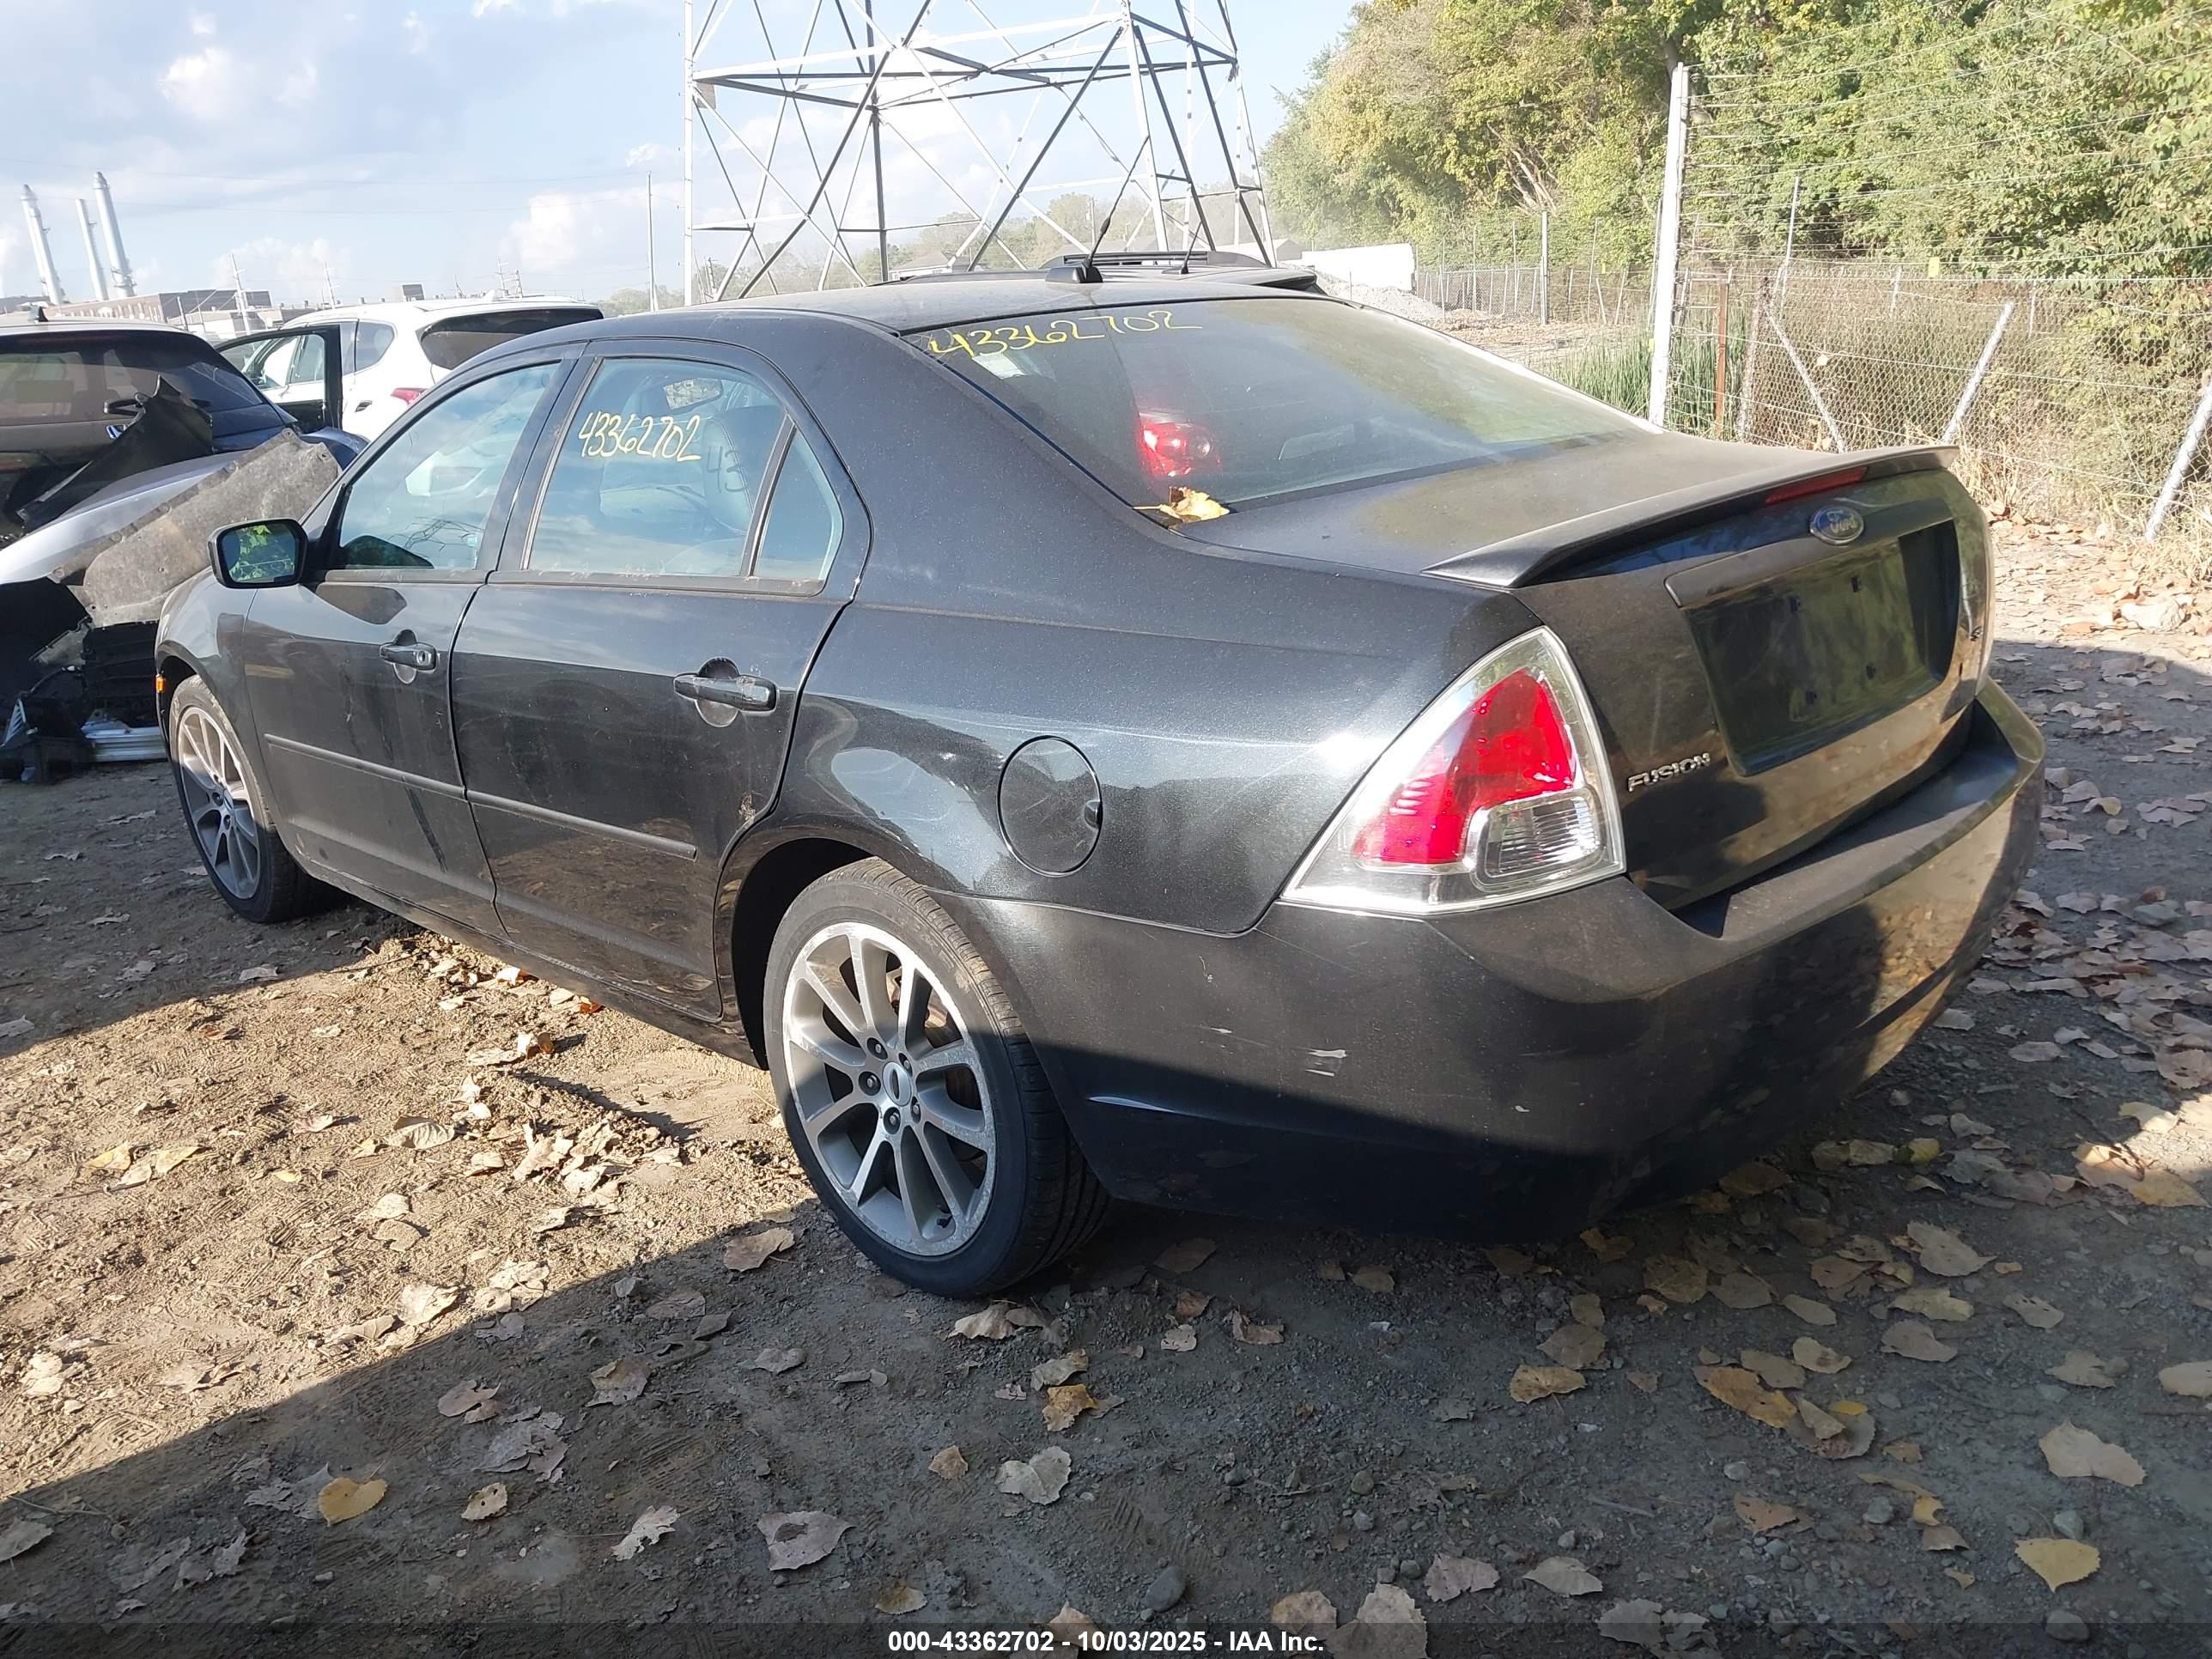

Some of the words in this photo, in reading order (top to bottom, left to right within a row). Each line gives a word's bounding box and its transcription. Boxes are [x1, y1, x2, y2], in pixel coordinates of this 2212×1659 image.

[930, 310, 1203, 356] 43362702
[578, 410, 702, 462] 43362702
[1627, 751, 1711, 792] FUSION
